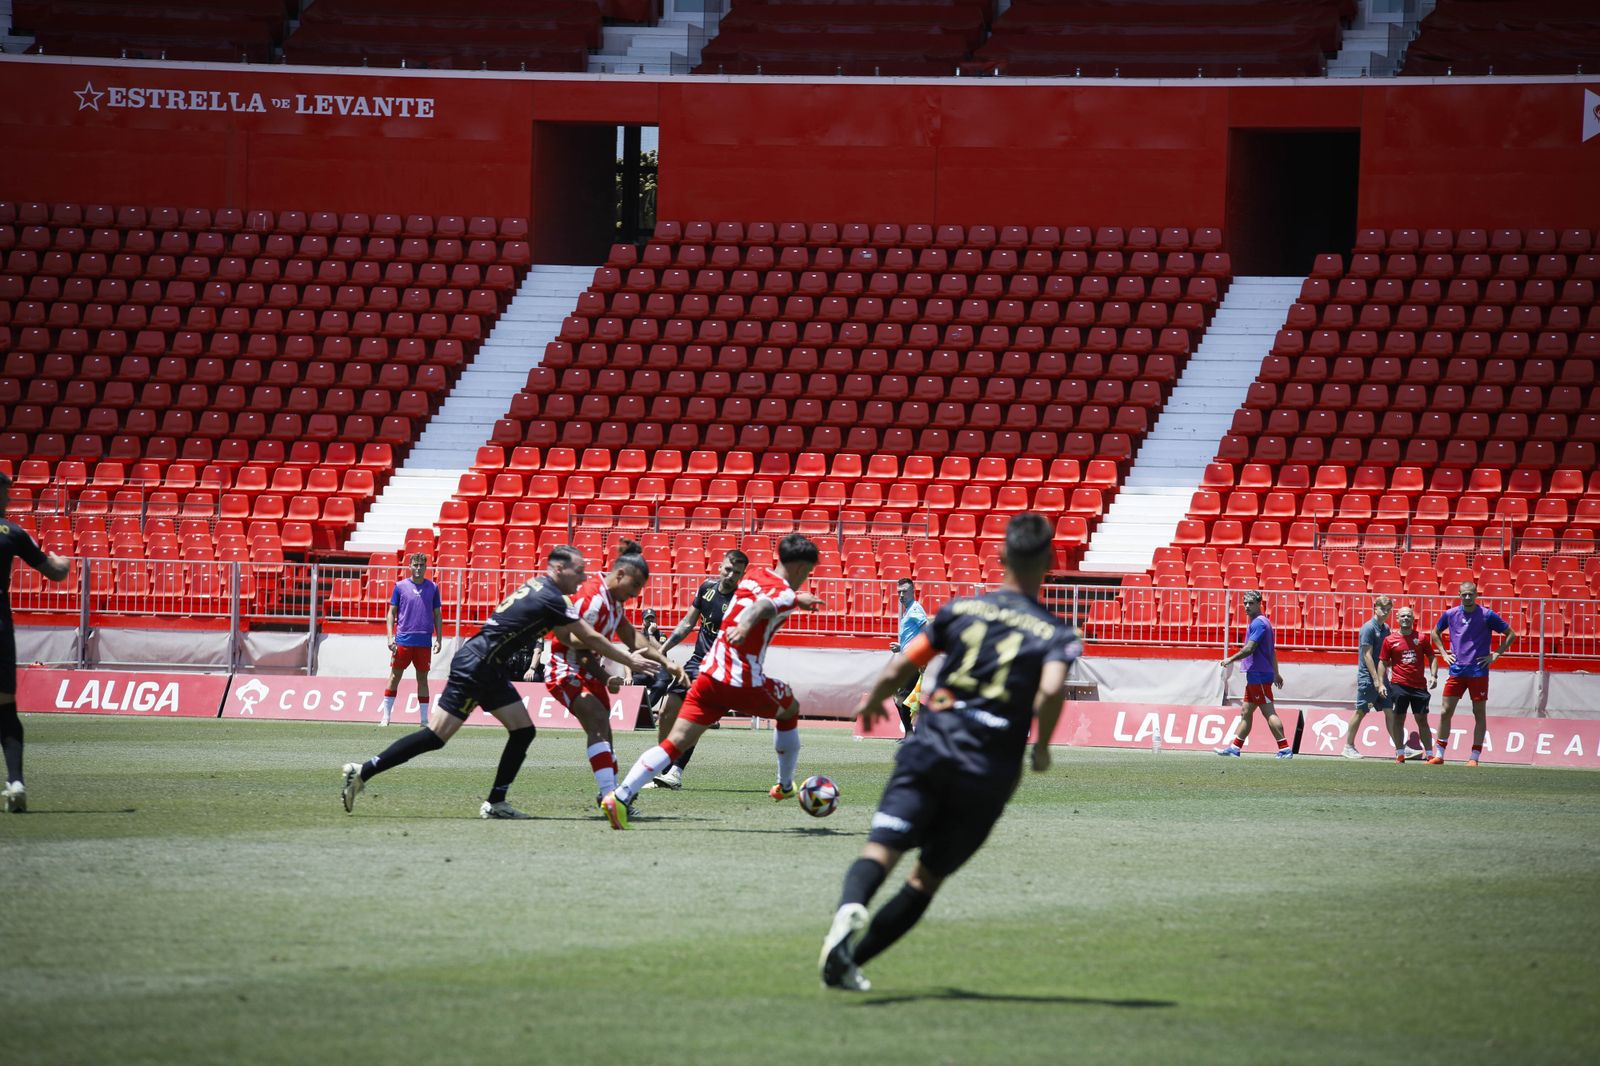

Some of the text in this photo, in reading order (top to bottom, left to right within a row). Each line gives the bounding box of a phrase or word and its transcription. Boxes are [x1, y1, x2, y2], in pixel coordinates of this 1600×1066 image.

[107, 87, 435, 118] ESTRELLA DE LEVANTE
[702, 589, 716, 602] 10
[945, 620, 1025, 700] 11
[55, 679, 179, 712] LALIGA
[1113, 711, 1249, 746] LALIGA
